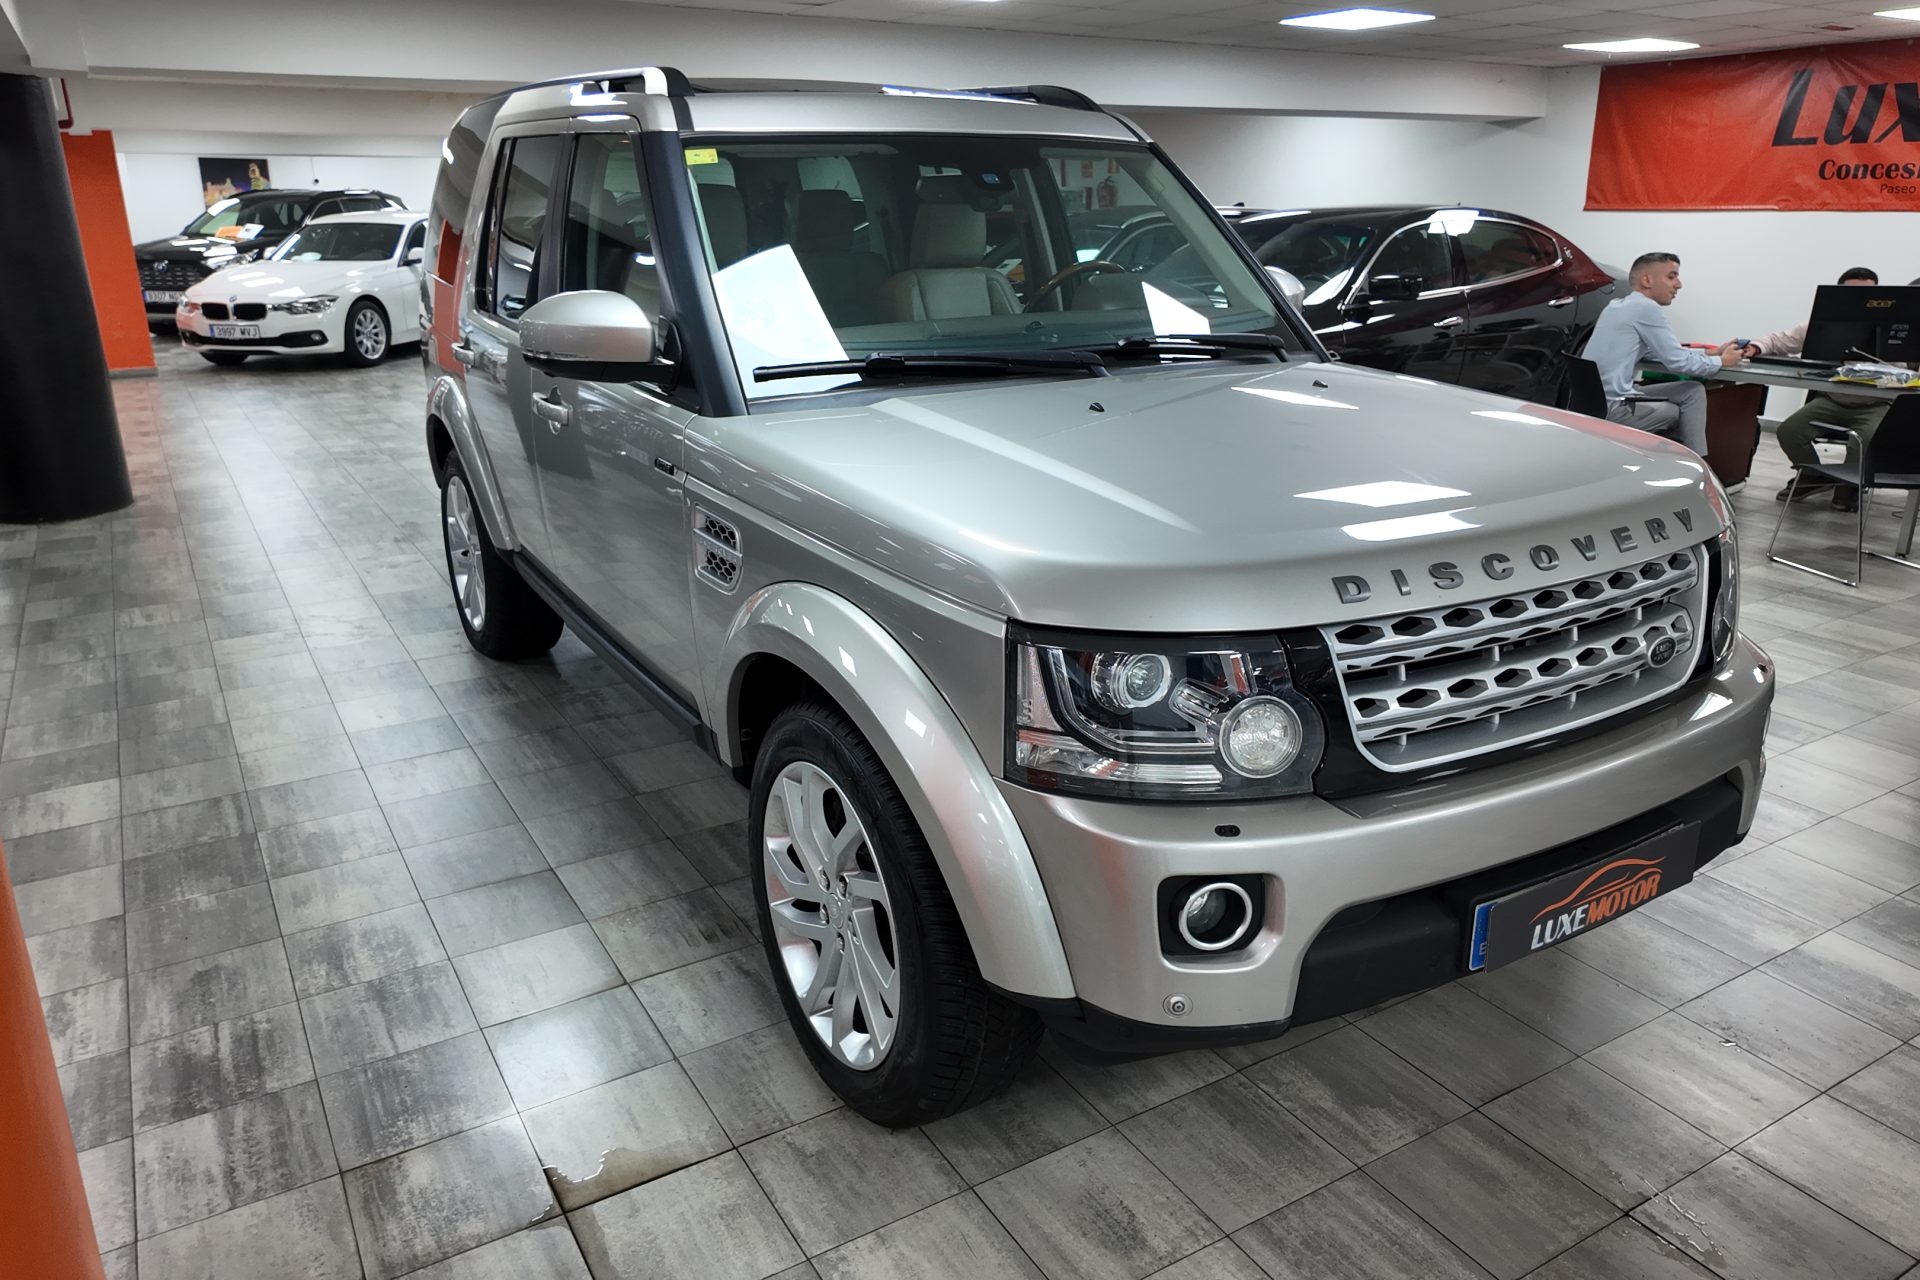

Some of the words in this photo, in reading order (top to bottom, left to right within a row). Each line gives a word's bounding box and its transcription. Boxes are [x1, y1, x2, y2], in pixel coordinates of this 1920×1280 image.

[1879, 183, 1917, 194] Paseo
[1866, 299, 1897, 308] acer
[1331, 507, 1694, 605] DISCOVERY
